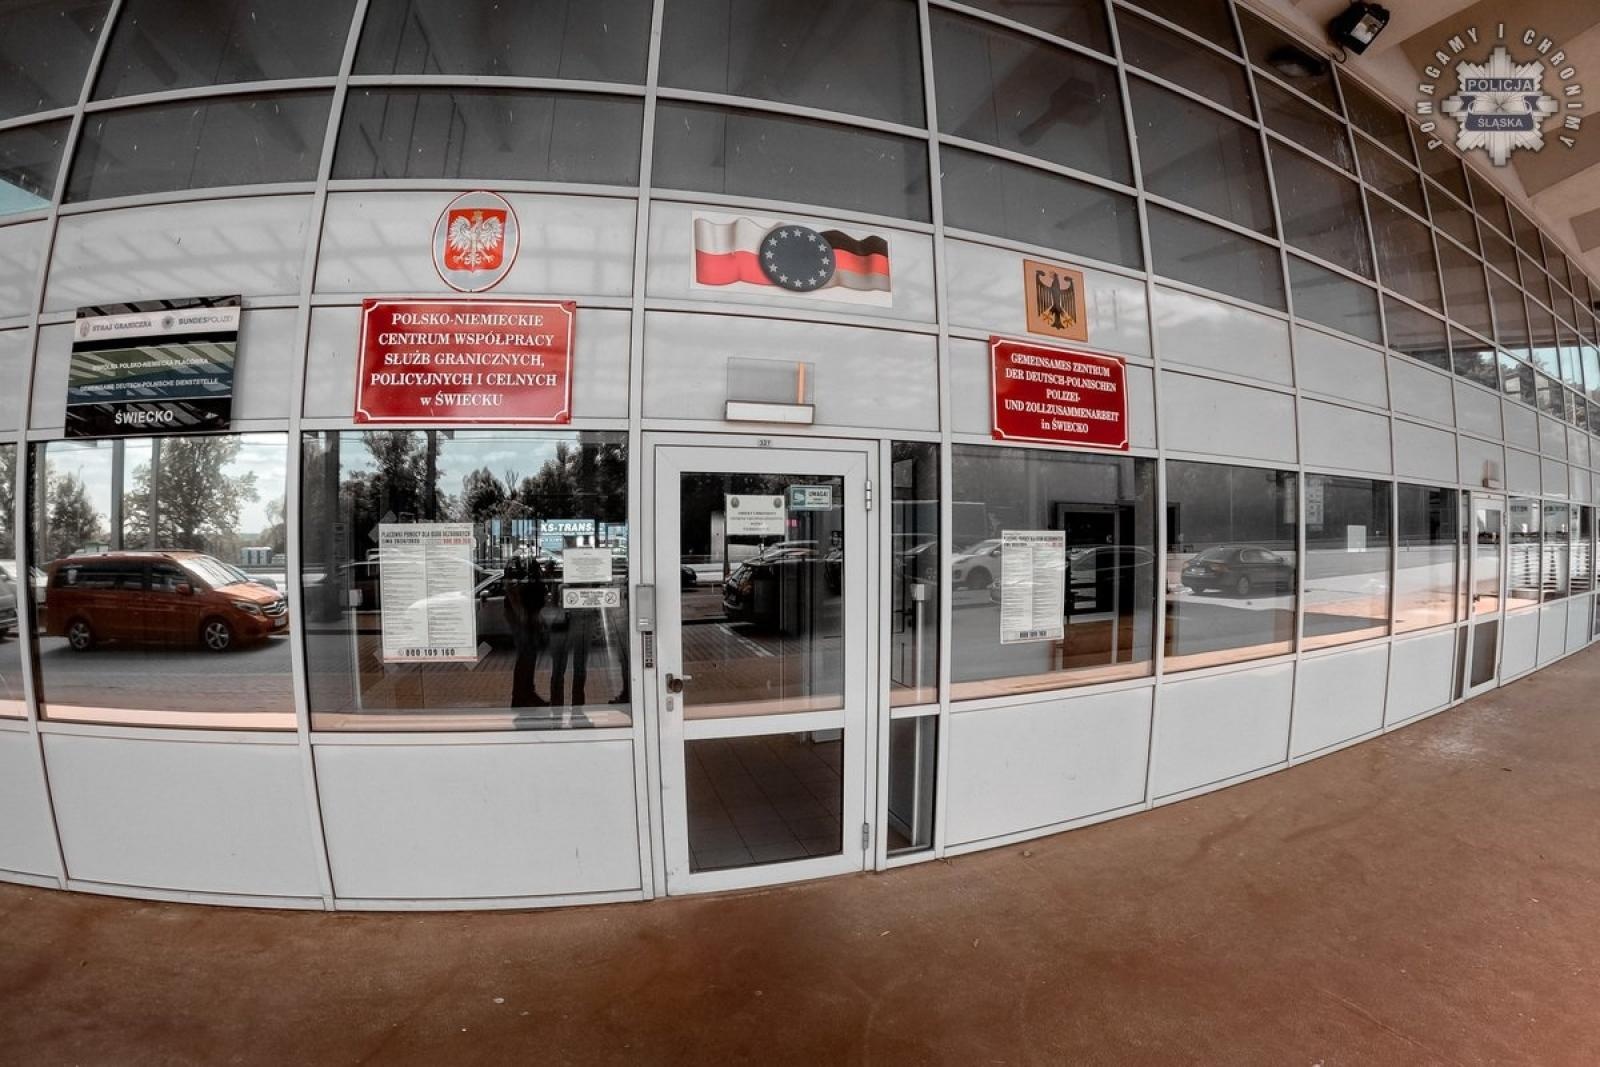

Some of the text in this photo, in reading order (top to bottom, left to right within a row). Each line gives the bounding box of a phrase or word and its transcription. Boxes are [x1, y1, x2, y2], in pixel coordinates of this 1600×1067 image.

[391, 312, 544, 326] POLSKO-NIEMIECKIE
[378, 330, 554, 346] CENTRUM WSPÓŁPRACY
[384, 350, 545, 367] SŁUŻB GRANICZNYCH,
[1011, 353, 1110, 377] GEMEINSAMES ZENTRUM
[370, 373, 557, 386] POLICYJNYCH I CELNYCH
[1005, 368, 1117, 392] DER DEUTSCH-POLNISCHEN
[420, 390, 503, 406] w ŚWIECKU
[1046, 389, 1081, 402] POLIZEI-
[114, 407, 174, 425] ŚWIECKO
[1004, 399, 1120, 421] UND ZOLLZUSAMMENARBEIT
[1041, 418, 1089, 433] in ŚWIECKO
